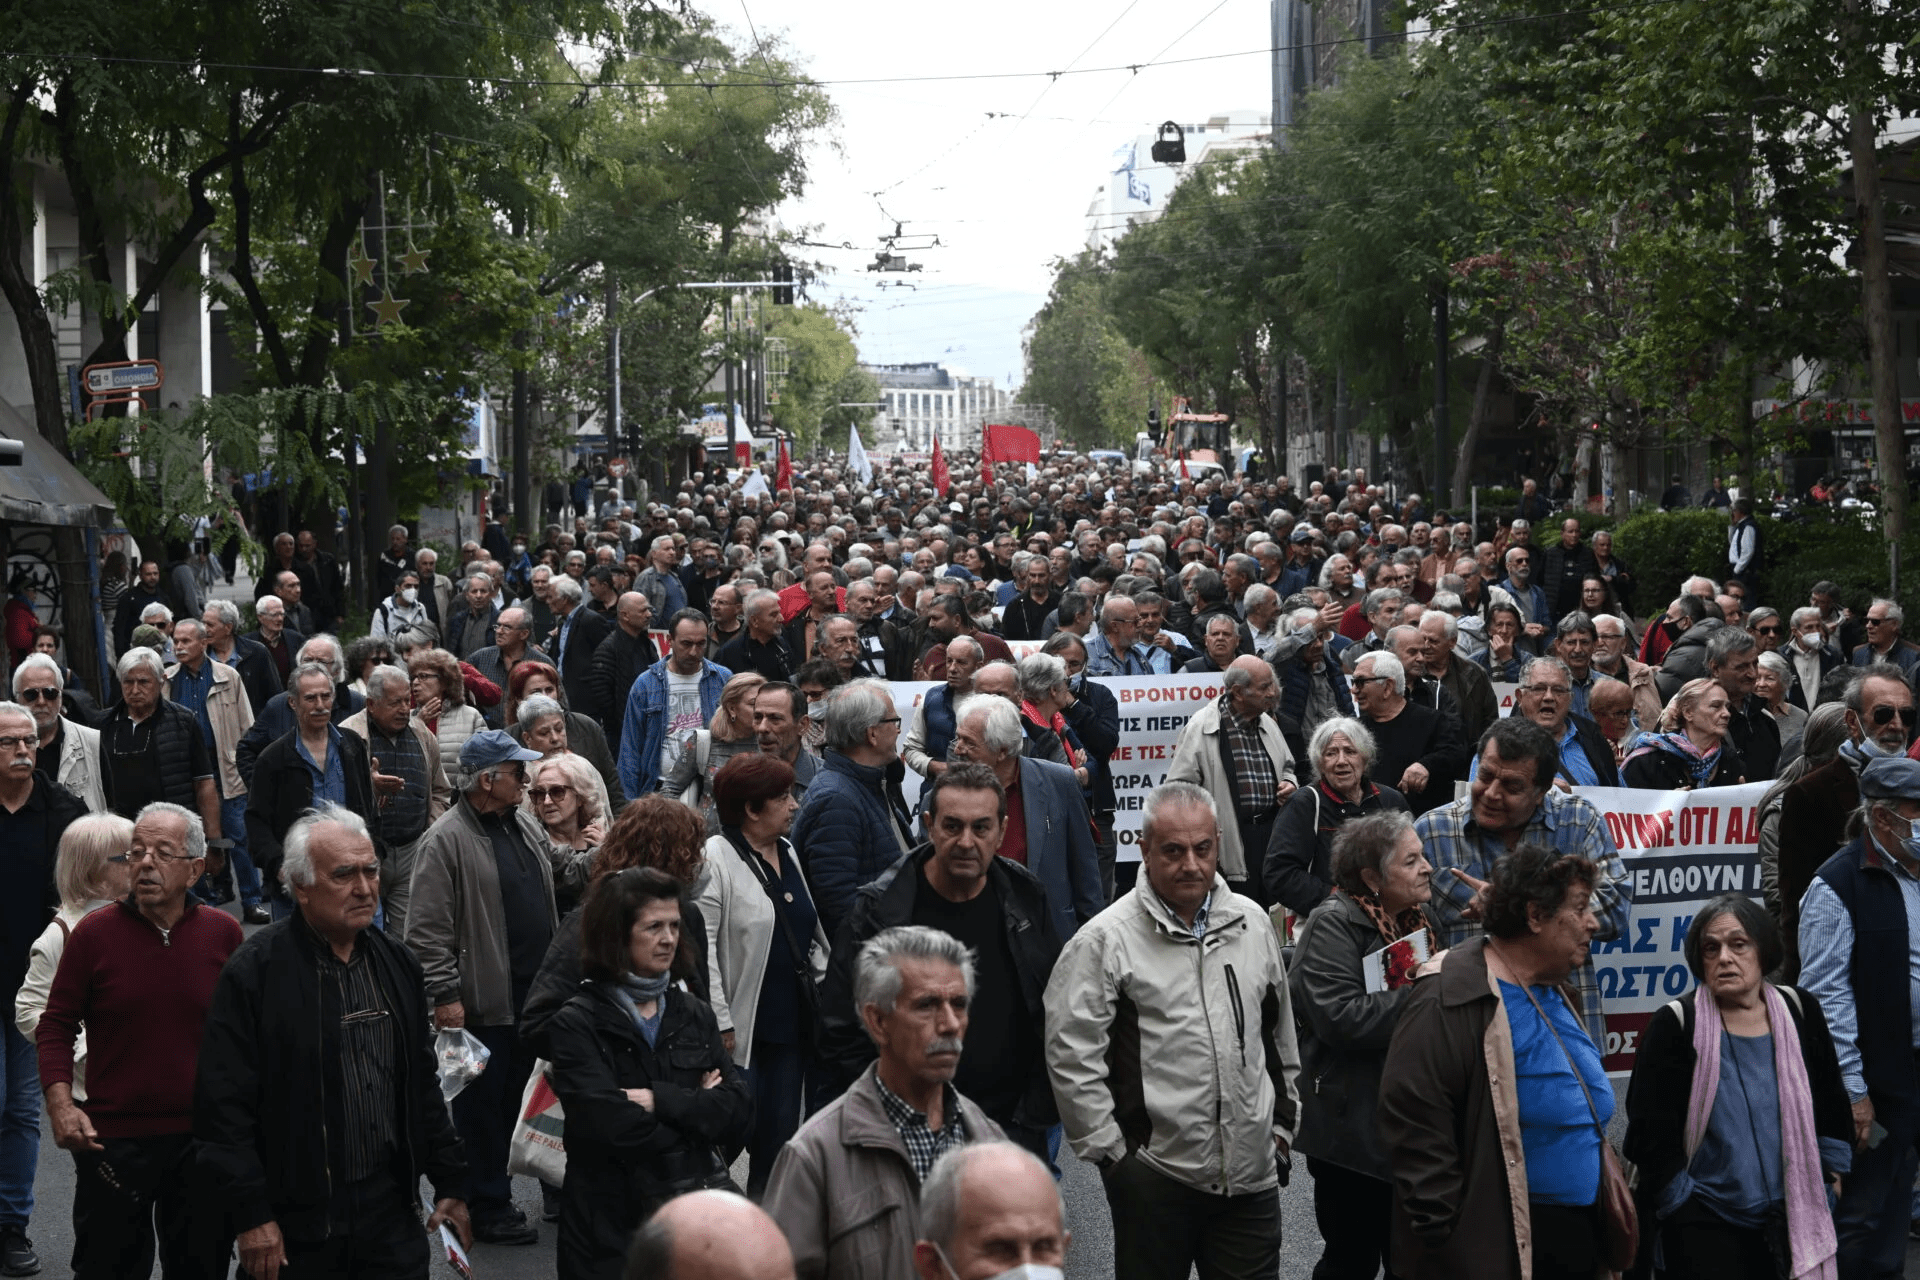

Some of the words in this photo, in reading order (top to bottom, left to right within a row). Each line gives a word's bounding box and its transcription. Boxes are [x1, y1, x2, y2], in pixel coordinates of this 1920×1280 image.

[1147, 716, 1192, 731] ΠΕΡΙ
[1138, 745, 1166, 760] ΤΙΣ
[1603, 809, 1675, 850] ΟΥΜΕ
[1679, 806, 1719, 847] ΟΤΙ
[1628, 864, 1744, 897] ΕΛΘΟΥΝ
[1591, 918, 1661, 955] ΑΣ
[1596, 964, 1702, 999] ΩΣΤΟ
